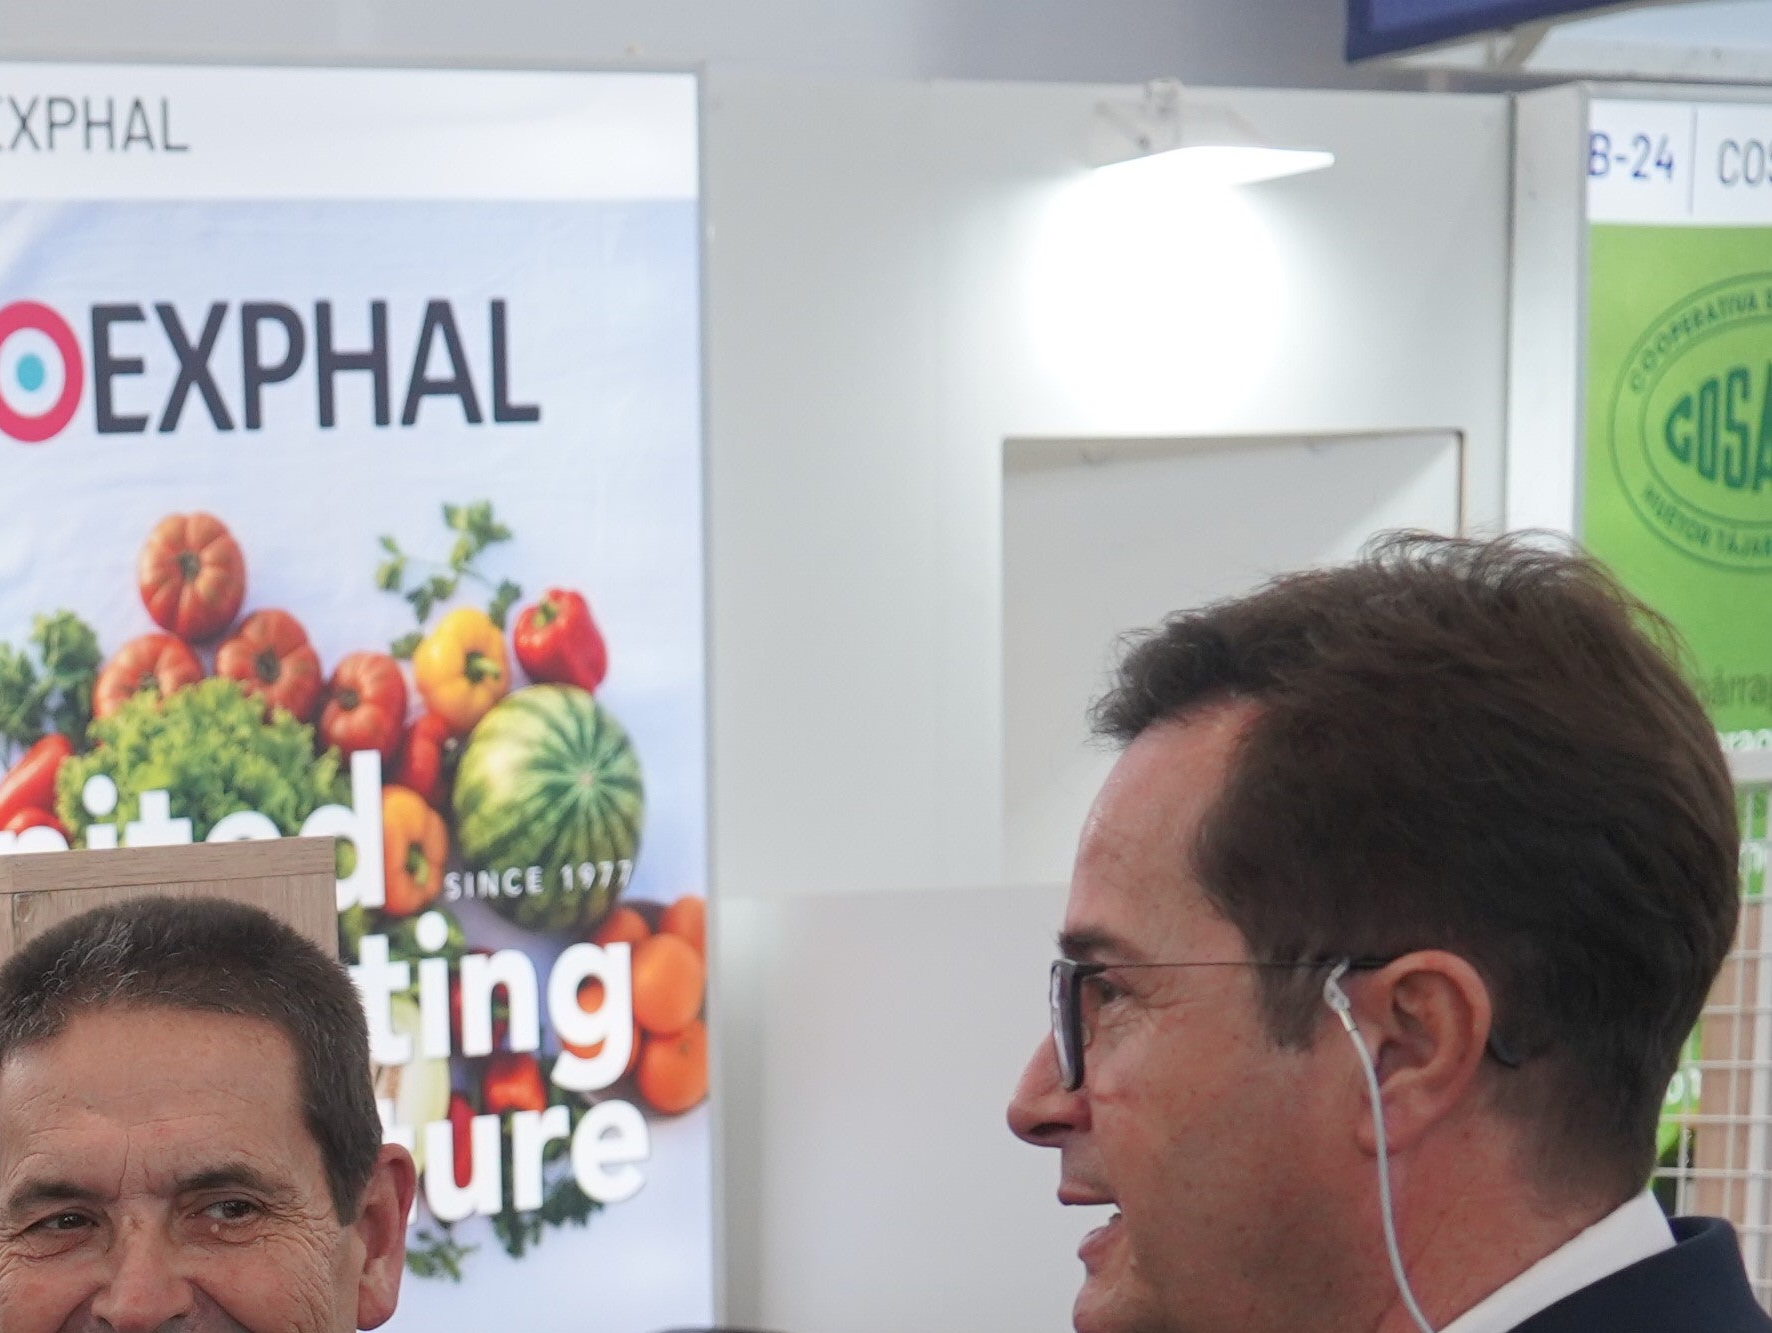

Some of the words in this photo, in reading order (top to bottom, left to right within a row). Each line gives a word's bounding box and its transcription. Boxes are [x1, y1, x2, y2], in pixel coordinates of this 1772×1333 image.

[1587, 131, 1674, 182] B-24
[1717, 137, 1772, 187] CO
[443, 865, 544, 900] SINCE
[561, 859, 634, 892] 1977
[348, 910, 634, 1092] ting
[376, 1098, 652, 1223] ure
